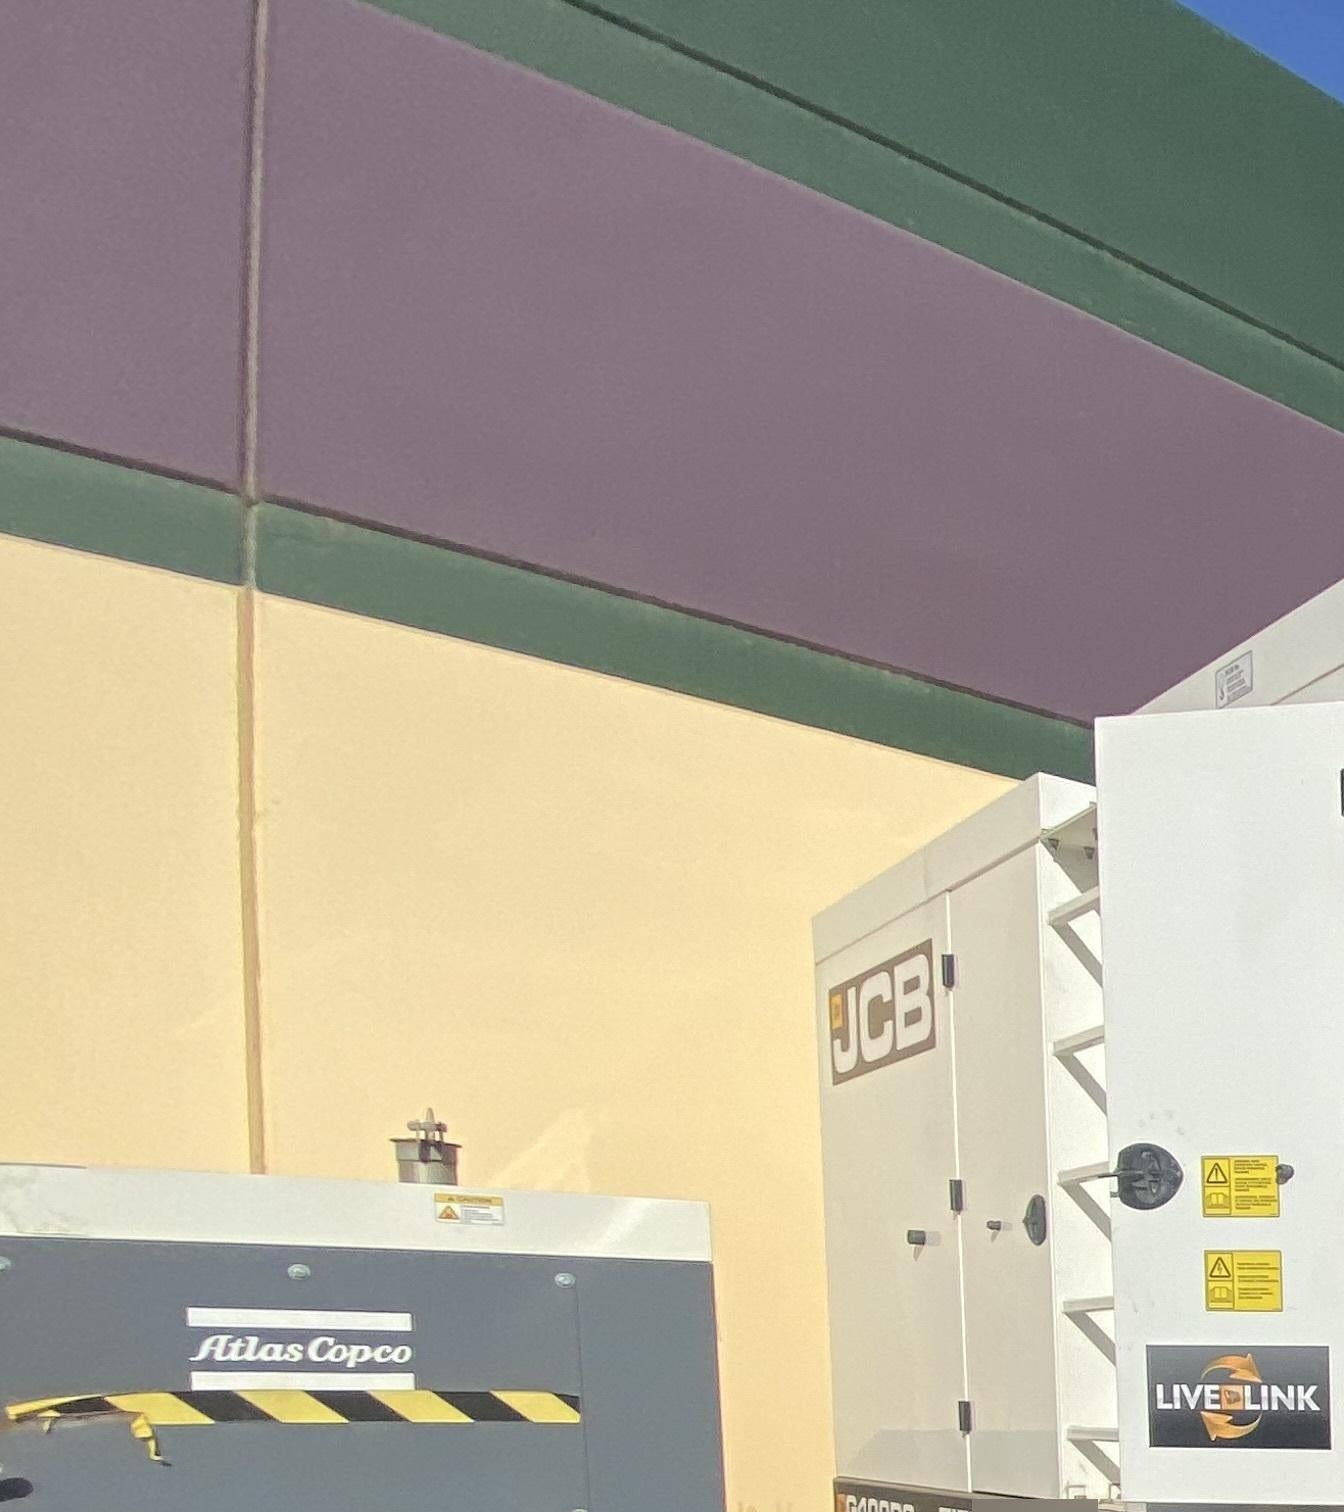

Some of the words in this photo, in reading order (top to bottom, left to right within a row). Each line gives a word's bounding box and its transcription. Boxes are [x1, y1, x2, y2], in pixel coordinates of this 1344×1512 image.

[832, 953, 933, 1074] JCB
[188, 1334, 304, 1363] Atlas
[307, 1335, 413, 1368] Copco
[1155, 1383, 1221, 1410] LIVE
[1243, 1384, 1321, 1411] LINK
